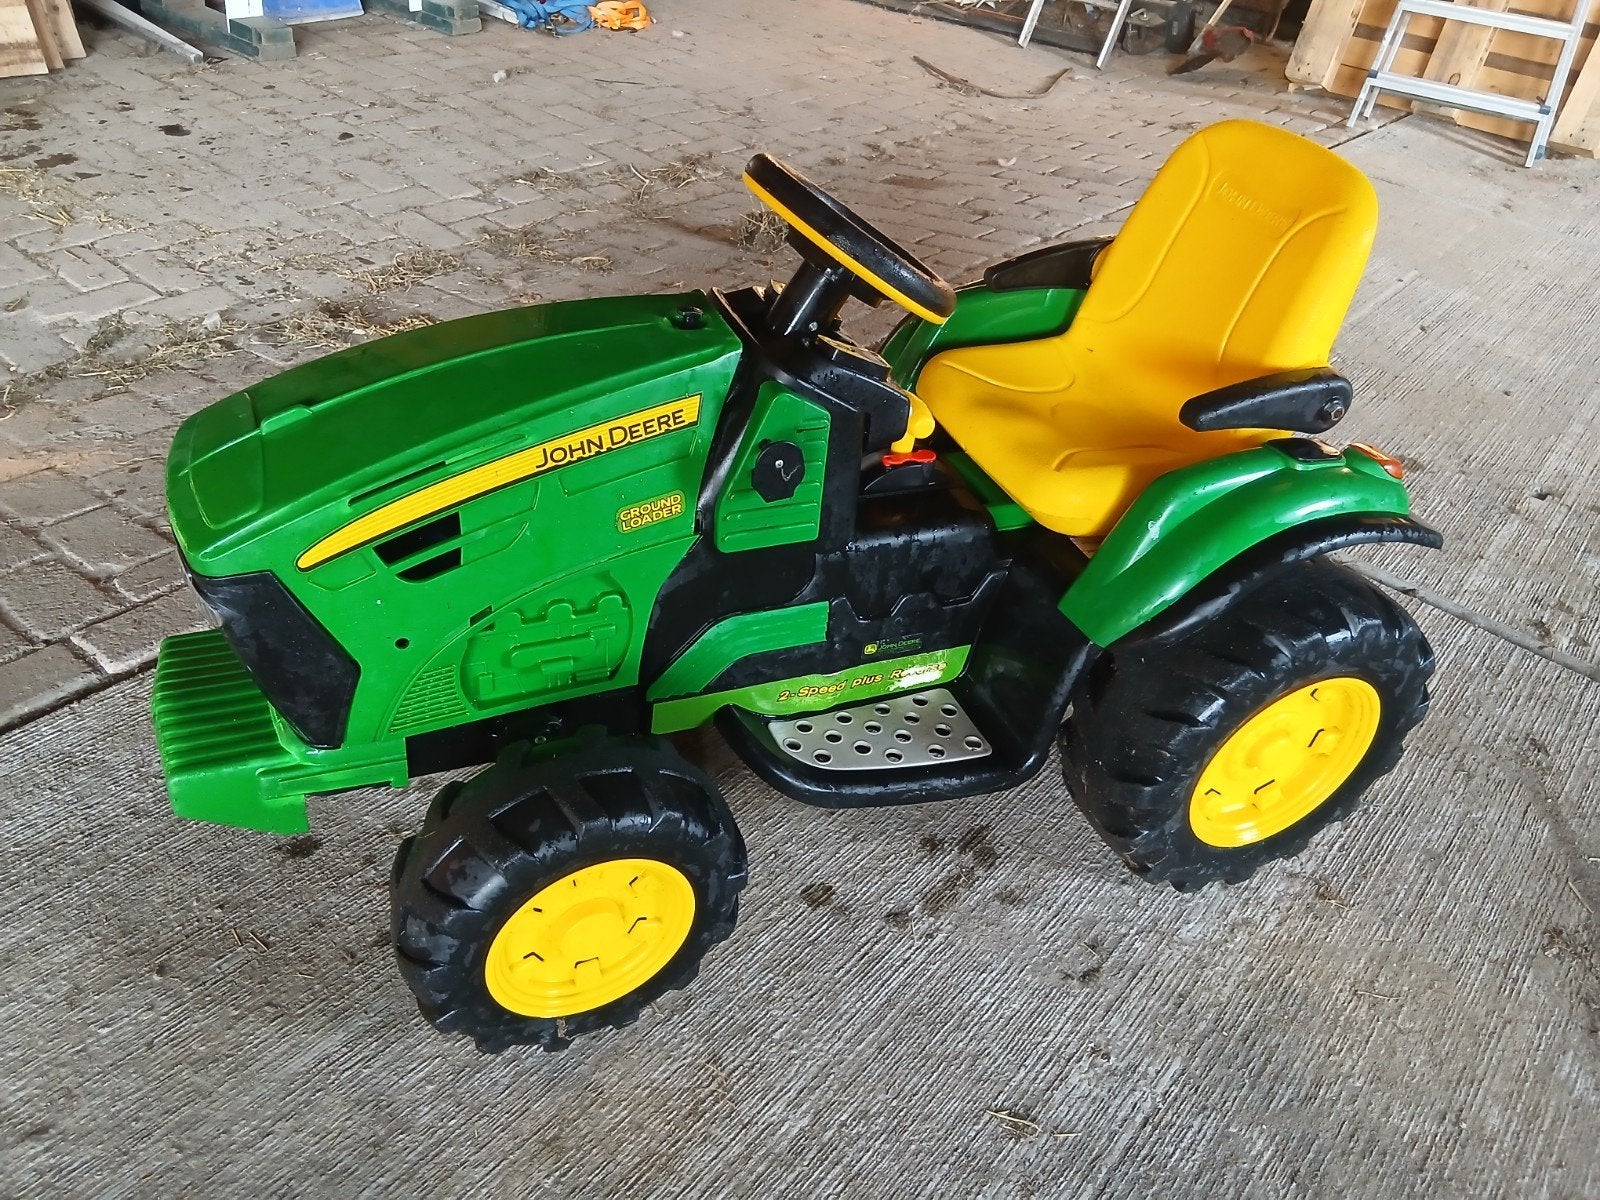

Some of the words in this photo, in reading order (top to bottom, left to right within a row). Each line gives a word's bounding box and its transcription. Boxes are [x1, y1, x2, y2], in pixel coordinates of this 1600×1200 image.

[536, 435, 604, 469] JOHN
[608, 408, 686, 446] DEERE
[620, 494, 682, 521] GROUND
[621, 504, 682, 531] LOADER
[777, 681, 847, 702] 2-Speed
